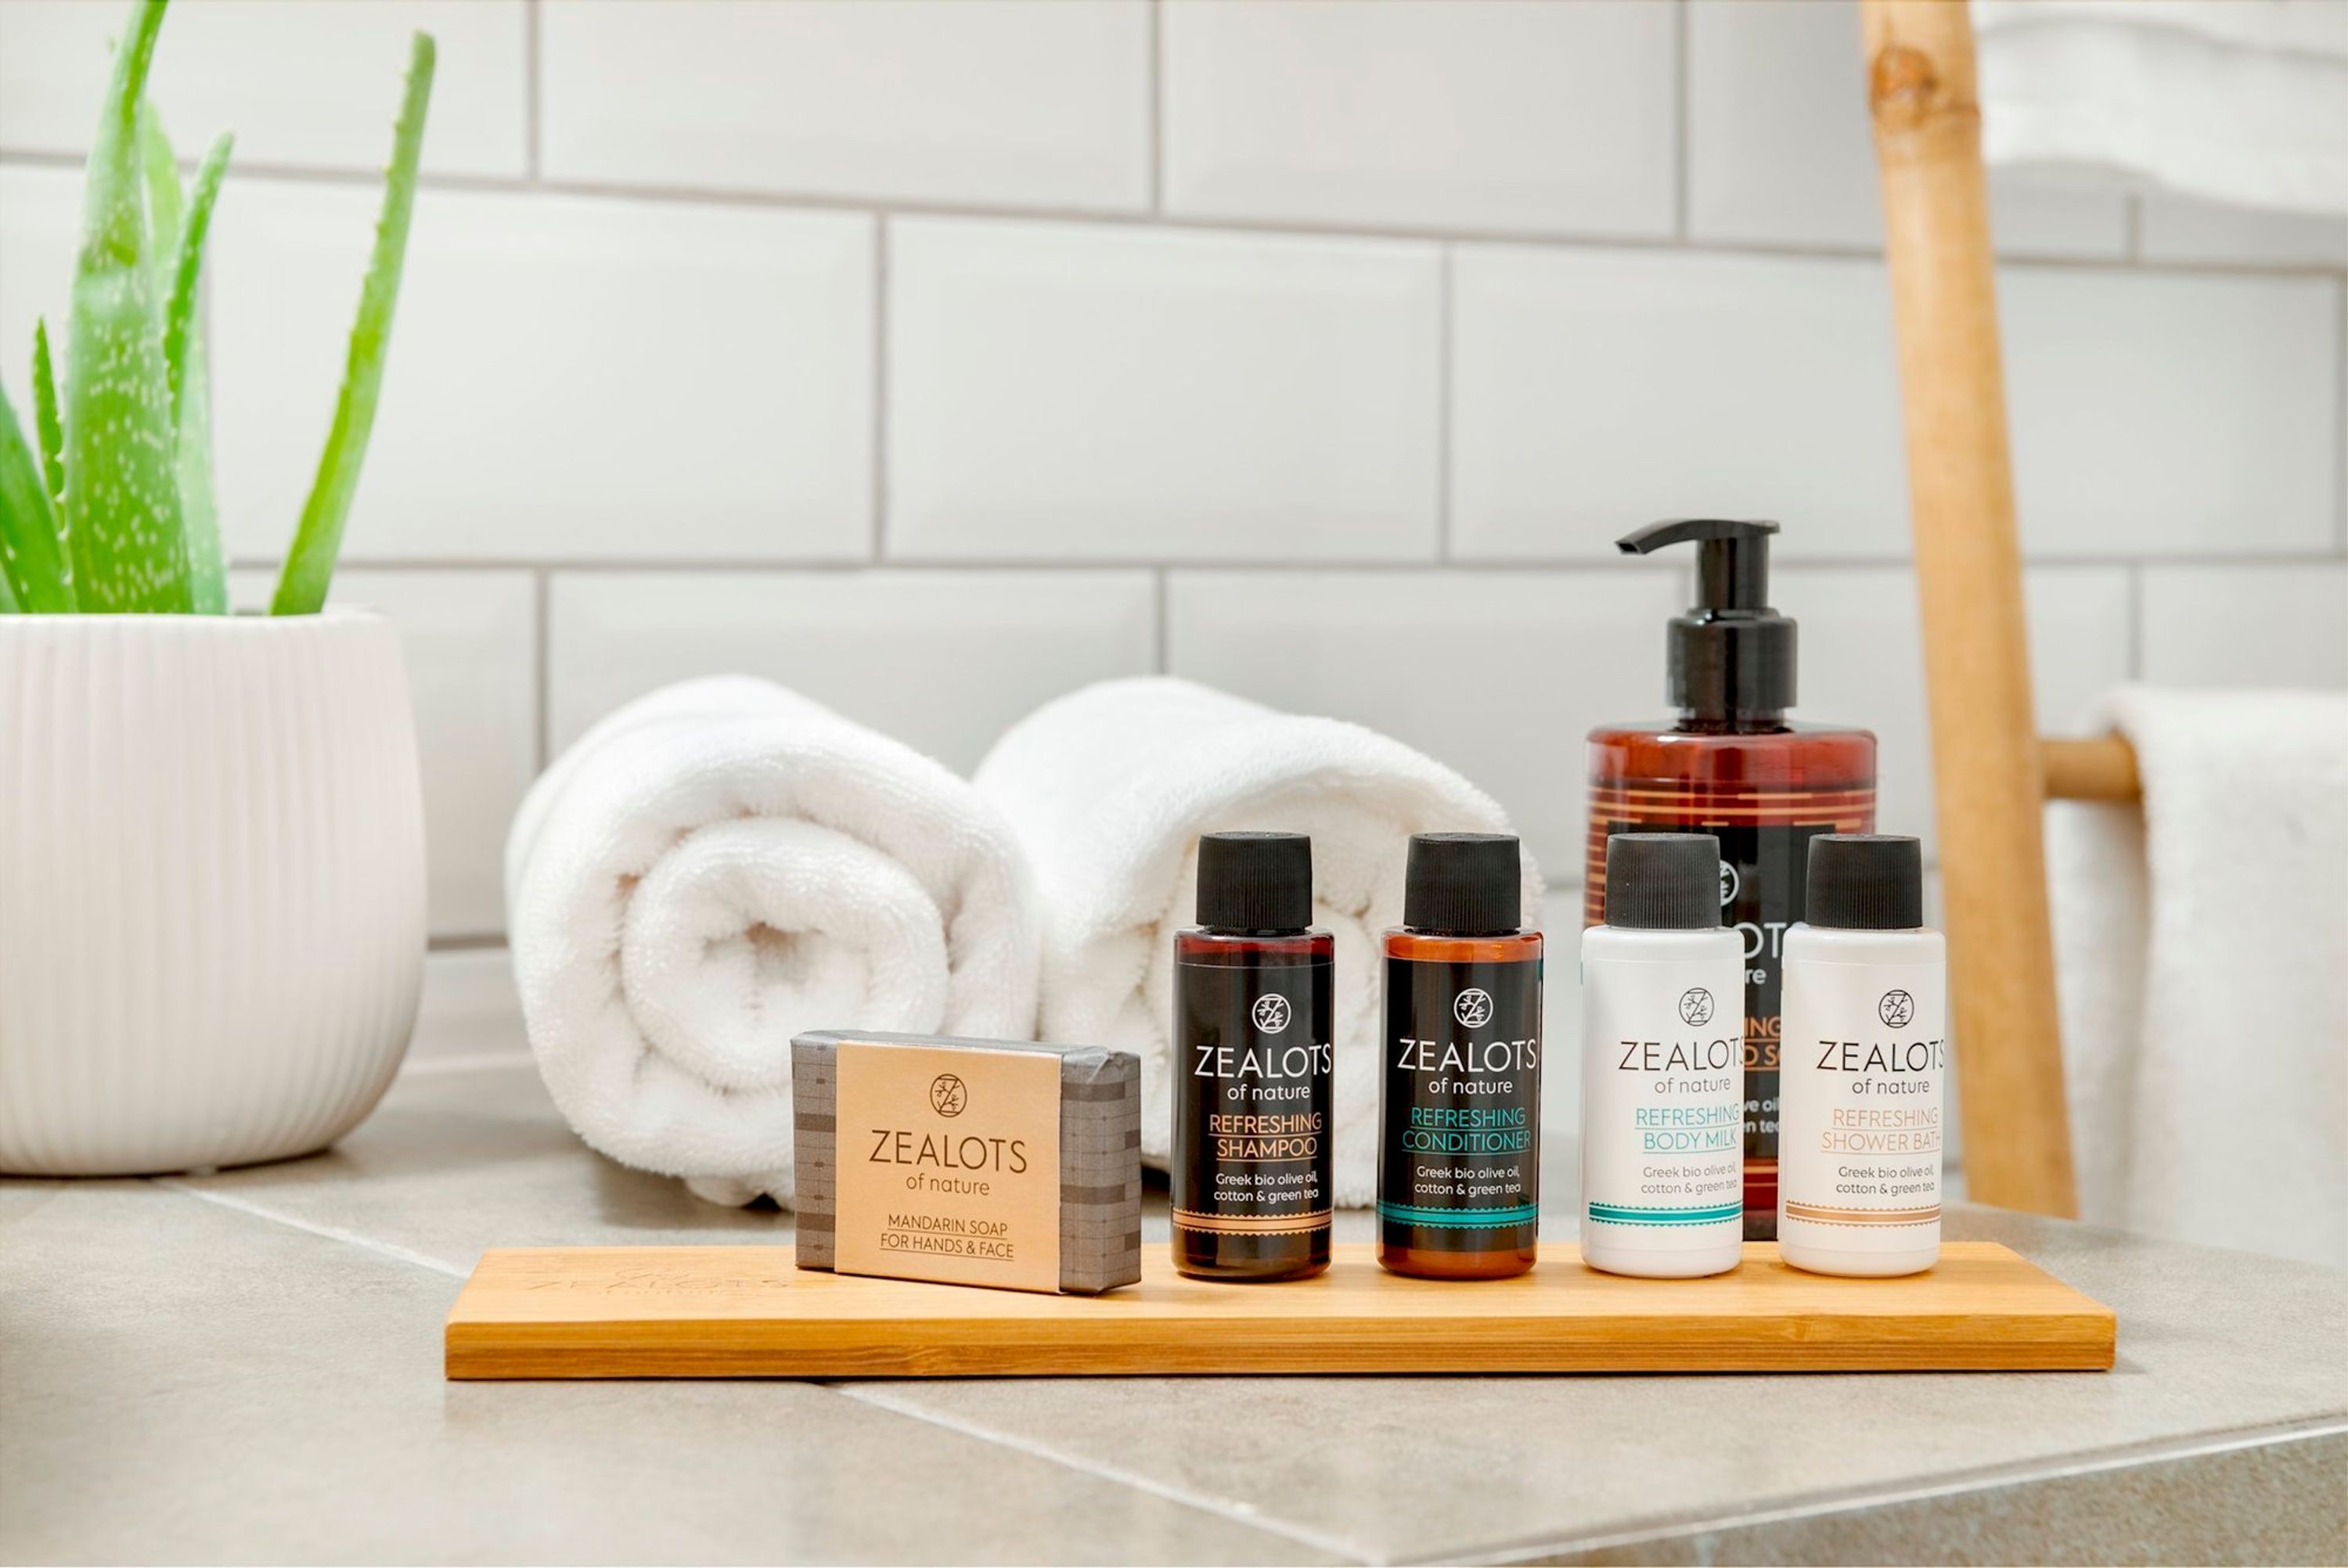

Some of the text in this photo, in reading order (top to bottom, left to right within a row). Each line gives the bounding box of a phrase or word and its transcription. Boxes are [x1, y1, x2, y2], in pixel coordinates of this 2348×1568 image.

[1194, 1043, 1331, 1079] ZEALOTS
[1397, 1038, 1536, 1072] ZEALOTS
[1227, 1084, 1311, 1101] of nature
[1428, 1077, 1513, 1094] of nature
[1655, 1077, 1730, 1093] of nature
[1852, 1078, 1930, 1094] of nature
[1210, 1112, 1322, 1133] REFRESHING
[1412, 1107, 1525, 1127] REFRESHING
[1637, 1103, 1739, 1125] REFRESHING
[1833, 1106, 1938, 1127] REFRESHING
[1217, 1137, 1317, 1158] SHAMPOO
[1403, 1130, 1531, 1151] CONDITIONER
[1644, 1127, 1736, 1149] BODY MILK
[1821, 1131, 1908, 1151] SHOWER
[870, 1130, 1027, 1174] ZEALOTS
[1215, 1174, 1251, 1185] Greek
[1255, 1174, 1275, 1185] bio
[1277, 1173, 1303, 1185] olive
[1417, 1166, 1452, 1178] Greek
[1455, 1167, 1475, 1179] bio
[1478, 1167, 1504, 1178] olive
[1644, 1167, 1680, 1178] Greek
[1683, 1167, 1702, 1177] bio
[1704, 1165, 1726, 1176] olive
[1838, 1166, 1874, 1178] Greek
[1878, 1167, 1897, 1178] bio
[1900, 1167, 1923, 1178] olive
[906, 1173, 990, 1196] of nature
[1414, 1183, 1521, 1198] cotton & green tea
[1641, 1184, 1681, 1193] cotton
[1684, 1182, 1692, 1193] &
[1695, 1181, 1724, 1196] green
[1836, 1184, 1876, 1194] cotton
[1879, 1183, 1888, 1194] &
[1891, 1184, 1921, 1196] green
[1214, 1189, 1319, 1204] cotton & green tea
[888, 1214, 1007, 1236] MANDARIN SOAP
[880, 1233, 1014, 1258] FOR HANDS & FACE
